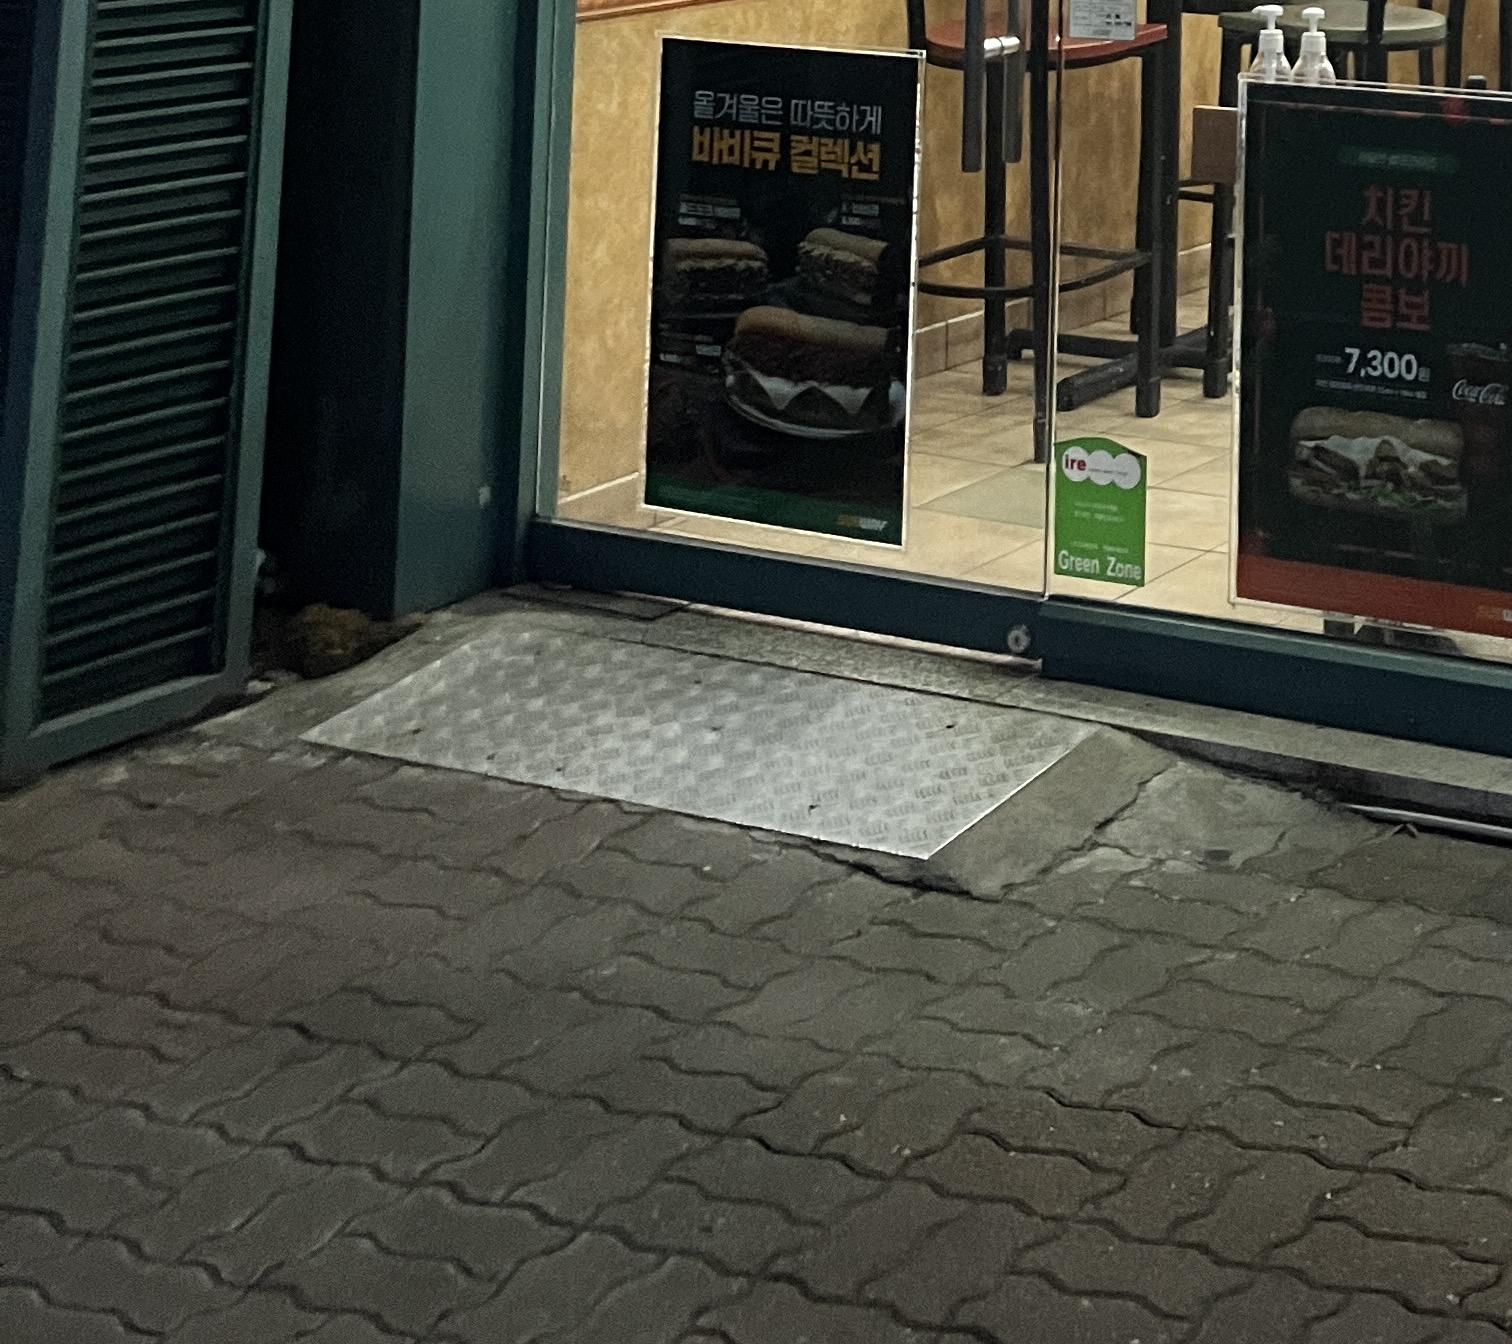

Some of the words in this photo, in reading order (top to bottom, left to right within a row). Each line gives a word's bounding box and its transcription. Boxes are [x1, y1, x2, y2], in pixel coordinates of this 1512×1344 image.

[694, 90, 783, 125] 올겨울은
[790, 99, 882, 135] 따뜻하게
[692, 126, 781, 171] 바비큐
[790, 134, 881, 181] 컬렉션
[1361, 183, 1433, 234] 치킨
[1324, 231, 1469, 288] 데리야끼
[1058, 549, 1100, 575] Green
[1106, 556, 1143, 580] Zone
